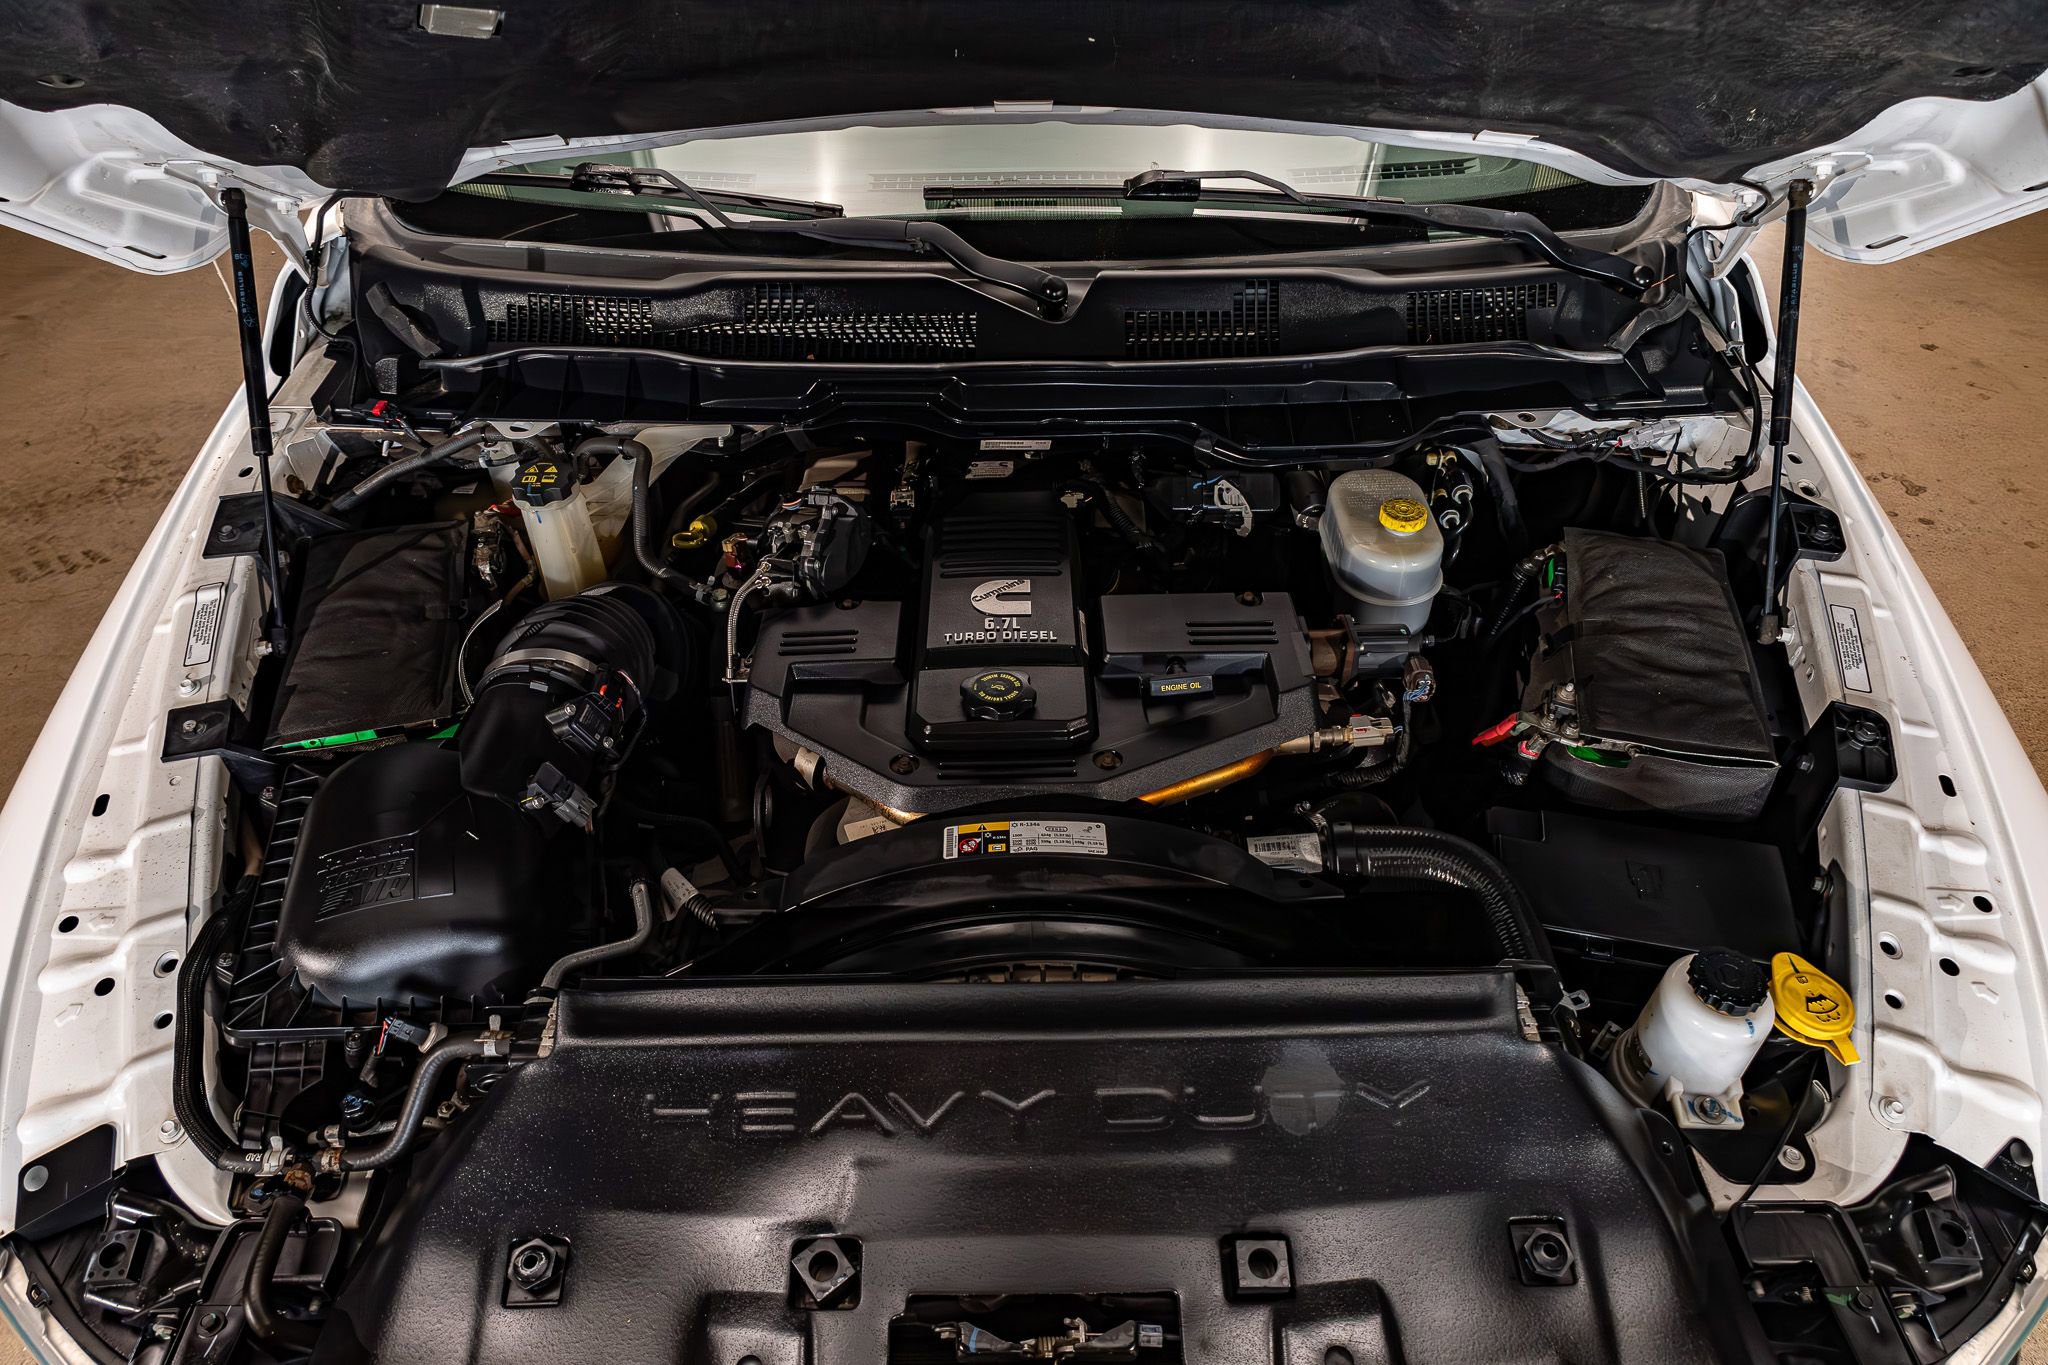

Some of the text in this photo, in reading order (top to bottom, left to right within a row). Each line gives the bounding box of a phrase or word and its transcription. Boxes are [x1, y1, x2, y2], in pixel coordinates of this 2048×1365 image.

[971, 579, 1025, 602] Cummins
[984, 617, 1021, 630] 6.7L
[944, 630, 1058, 643] TURBO DIESEL
[1161, 683, 1188, 692] ENGINE
[644, 1089, 1057, 1136] HEAVY
[245, 1153, 263, 1162] RAD
